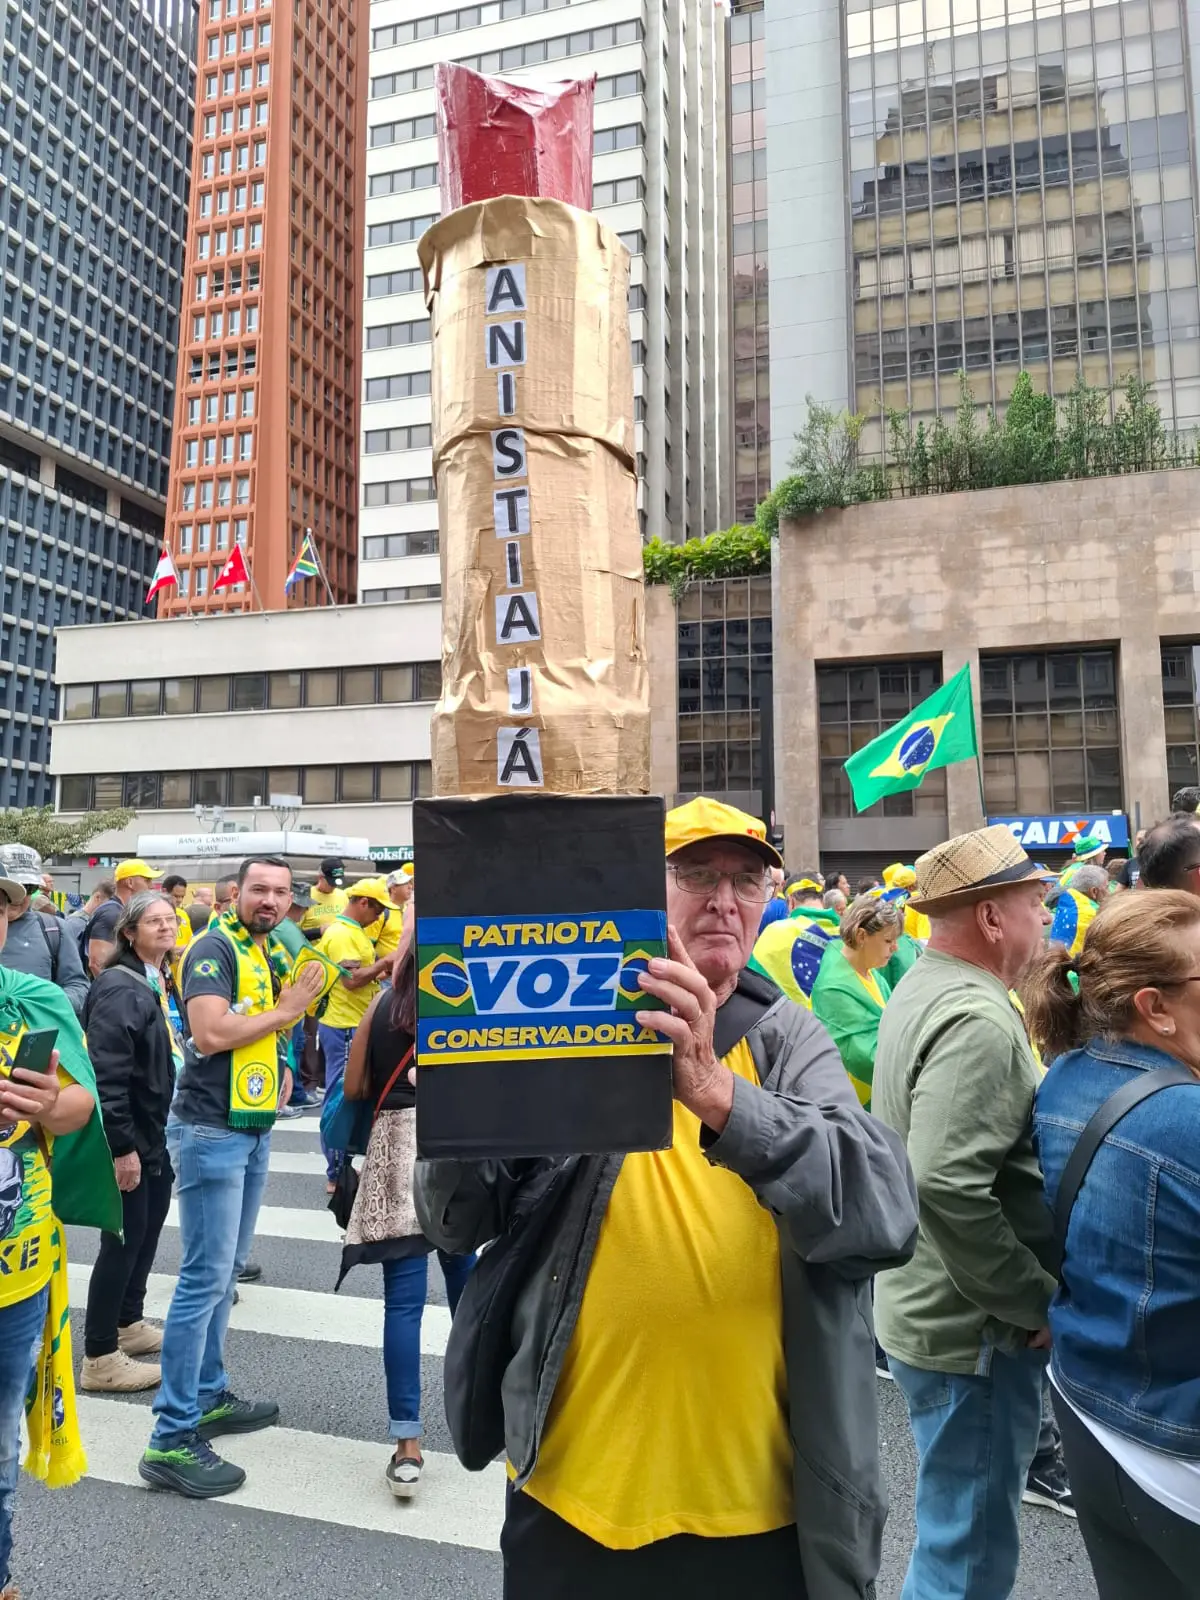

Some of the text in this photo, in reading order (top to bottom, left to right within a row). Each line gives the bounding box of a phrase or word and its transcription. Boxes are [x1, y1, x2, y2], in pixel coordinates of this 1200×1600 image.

[488, 268, 540, 638] ANISTIA
[500, 671, 540, 783] JÁ
[1007, 820, 1112, 844] CAIXA
[463, 921, 621, 948] PATRIOTA
[467, 957, 620, 1011] VOZ
[427, 1023, 658, 1050] CONSERVADORA
